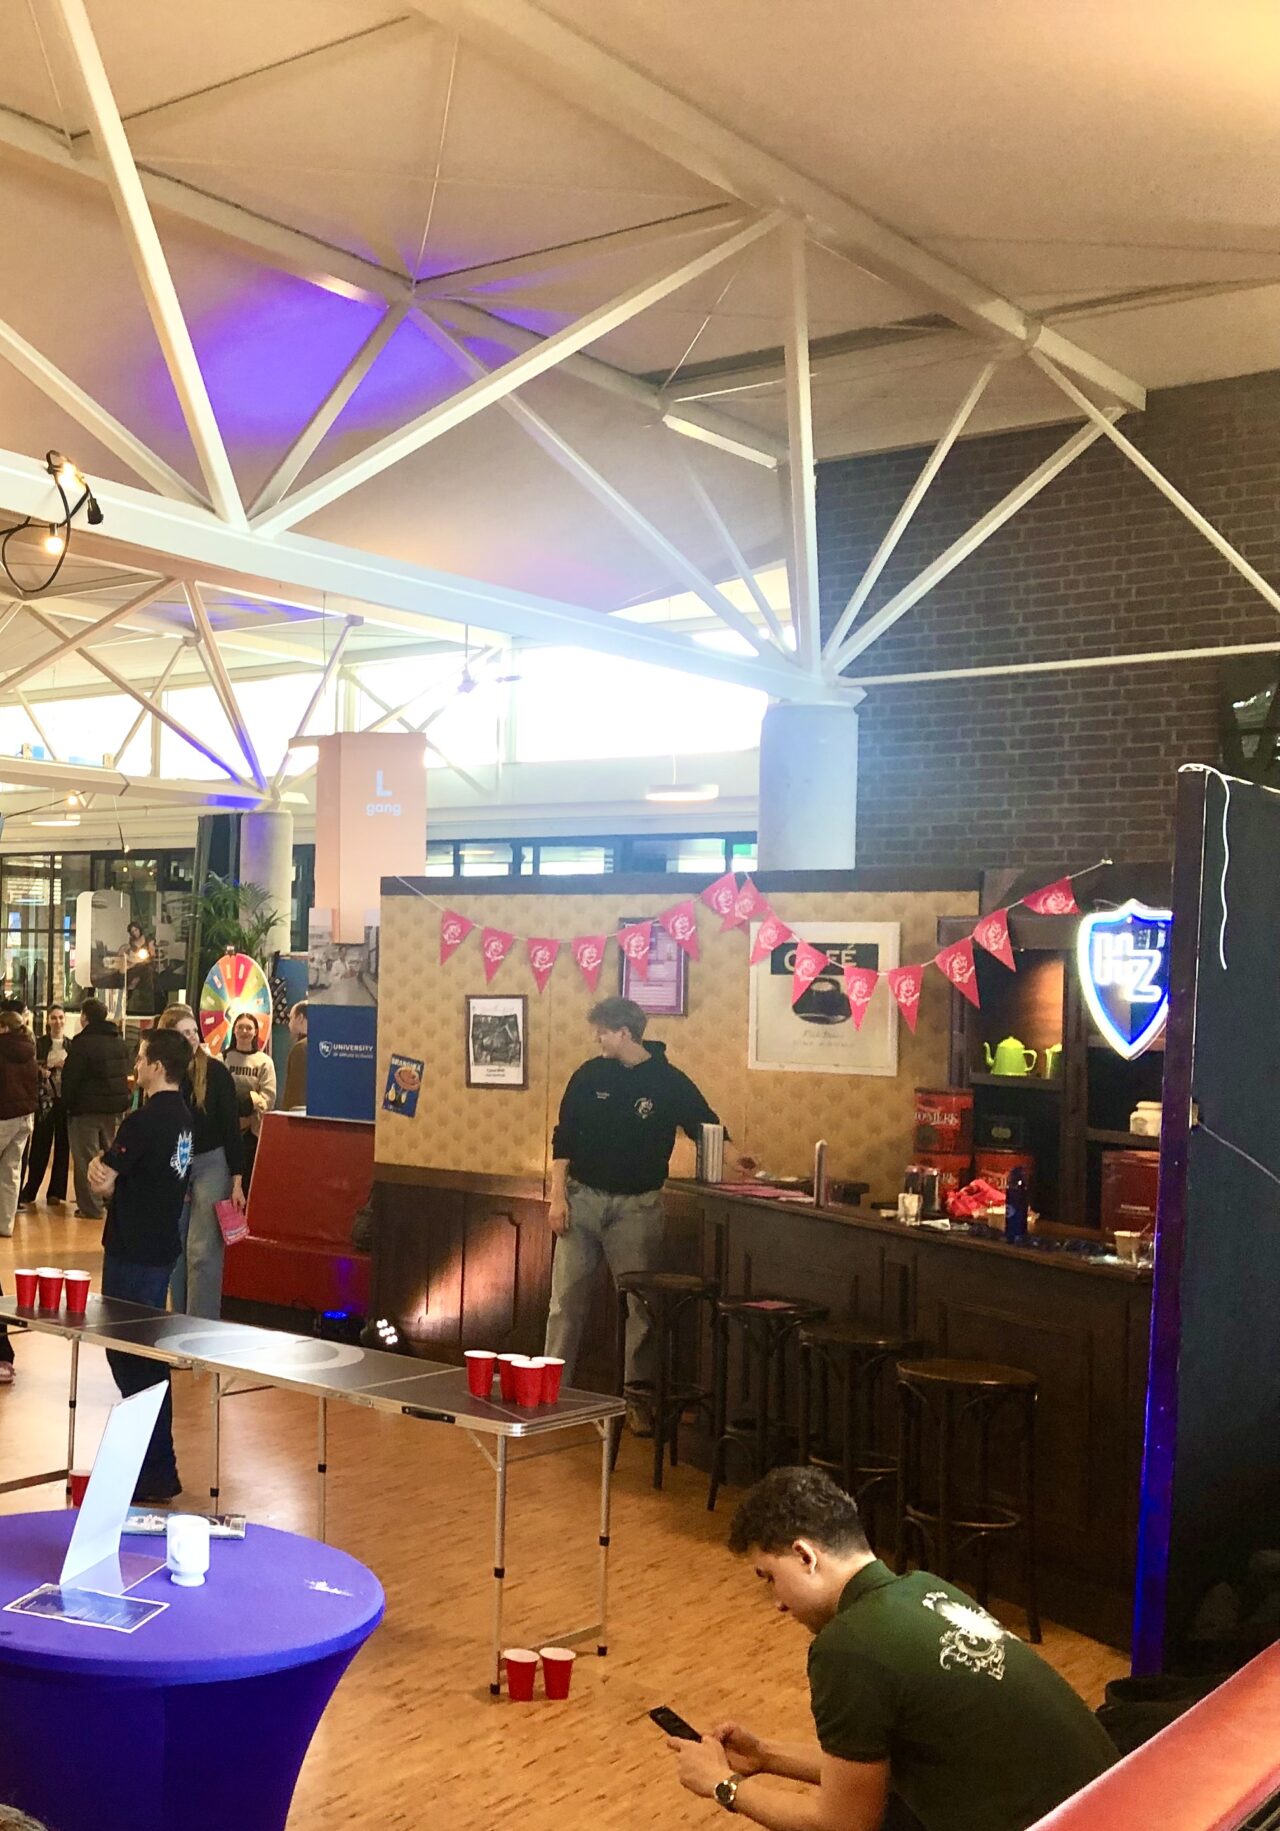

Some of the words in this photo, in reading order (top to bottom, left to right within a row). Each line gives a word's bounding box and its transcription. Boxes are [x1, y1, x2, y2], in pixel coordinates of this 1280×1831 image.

[376, 768, 393, 797] L
[367, 803, 401, 817] gang
[784, 945, 857, 972] CFÉ
[1093, 932, 1162, 1003] HZ
[333, 1043, 374, 1052] UNIVERSITY
